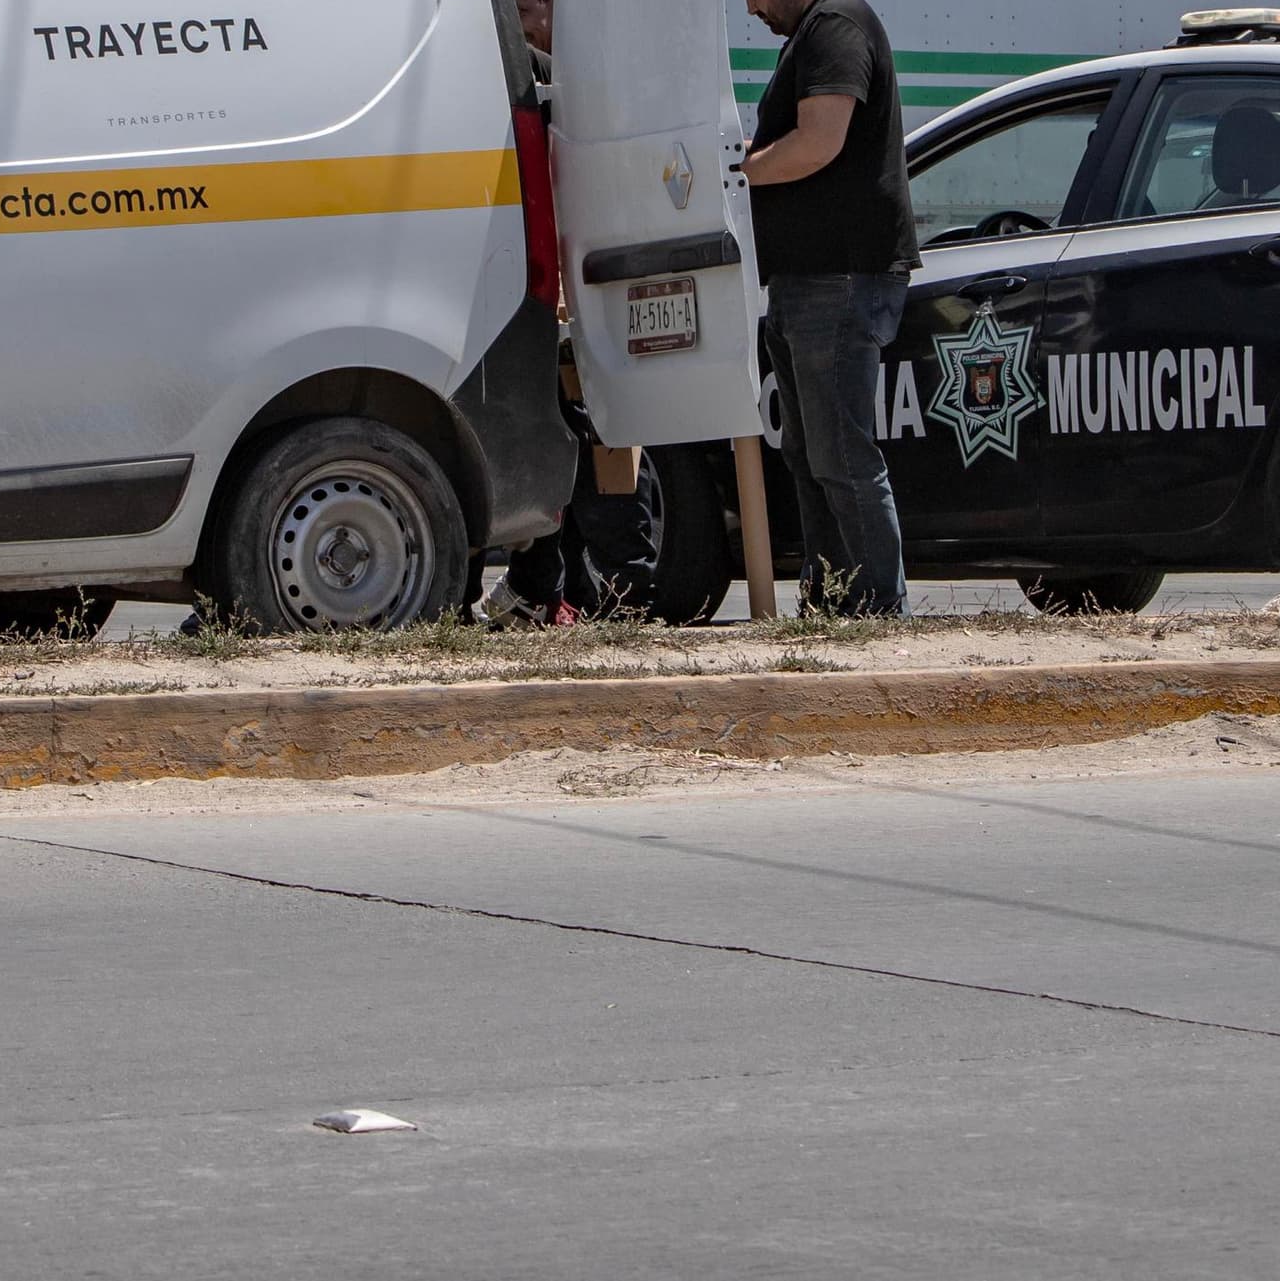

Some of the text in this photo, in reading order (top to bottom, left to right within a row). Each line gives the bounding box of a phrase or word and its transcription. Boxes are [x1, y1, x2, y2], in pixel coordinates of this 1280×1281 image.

[33, 18, 269, 61] TRAYECTA
[107, 109, 227, 127] TRANSPORTES
[1048, 346, 1266, 434] MUNICIPAL
